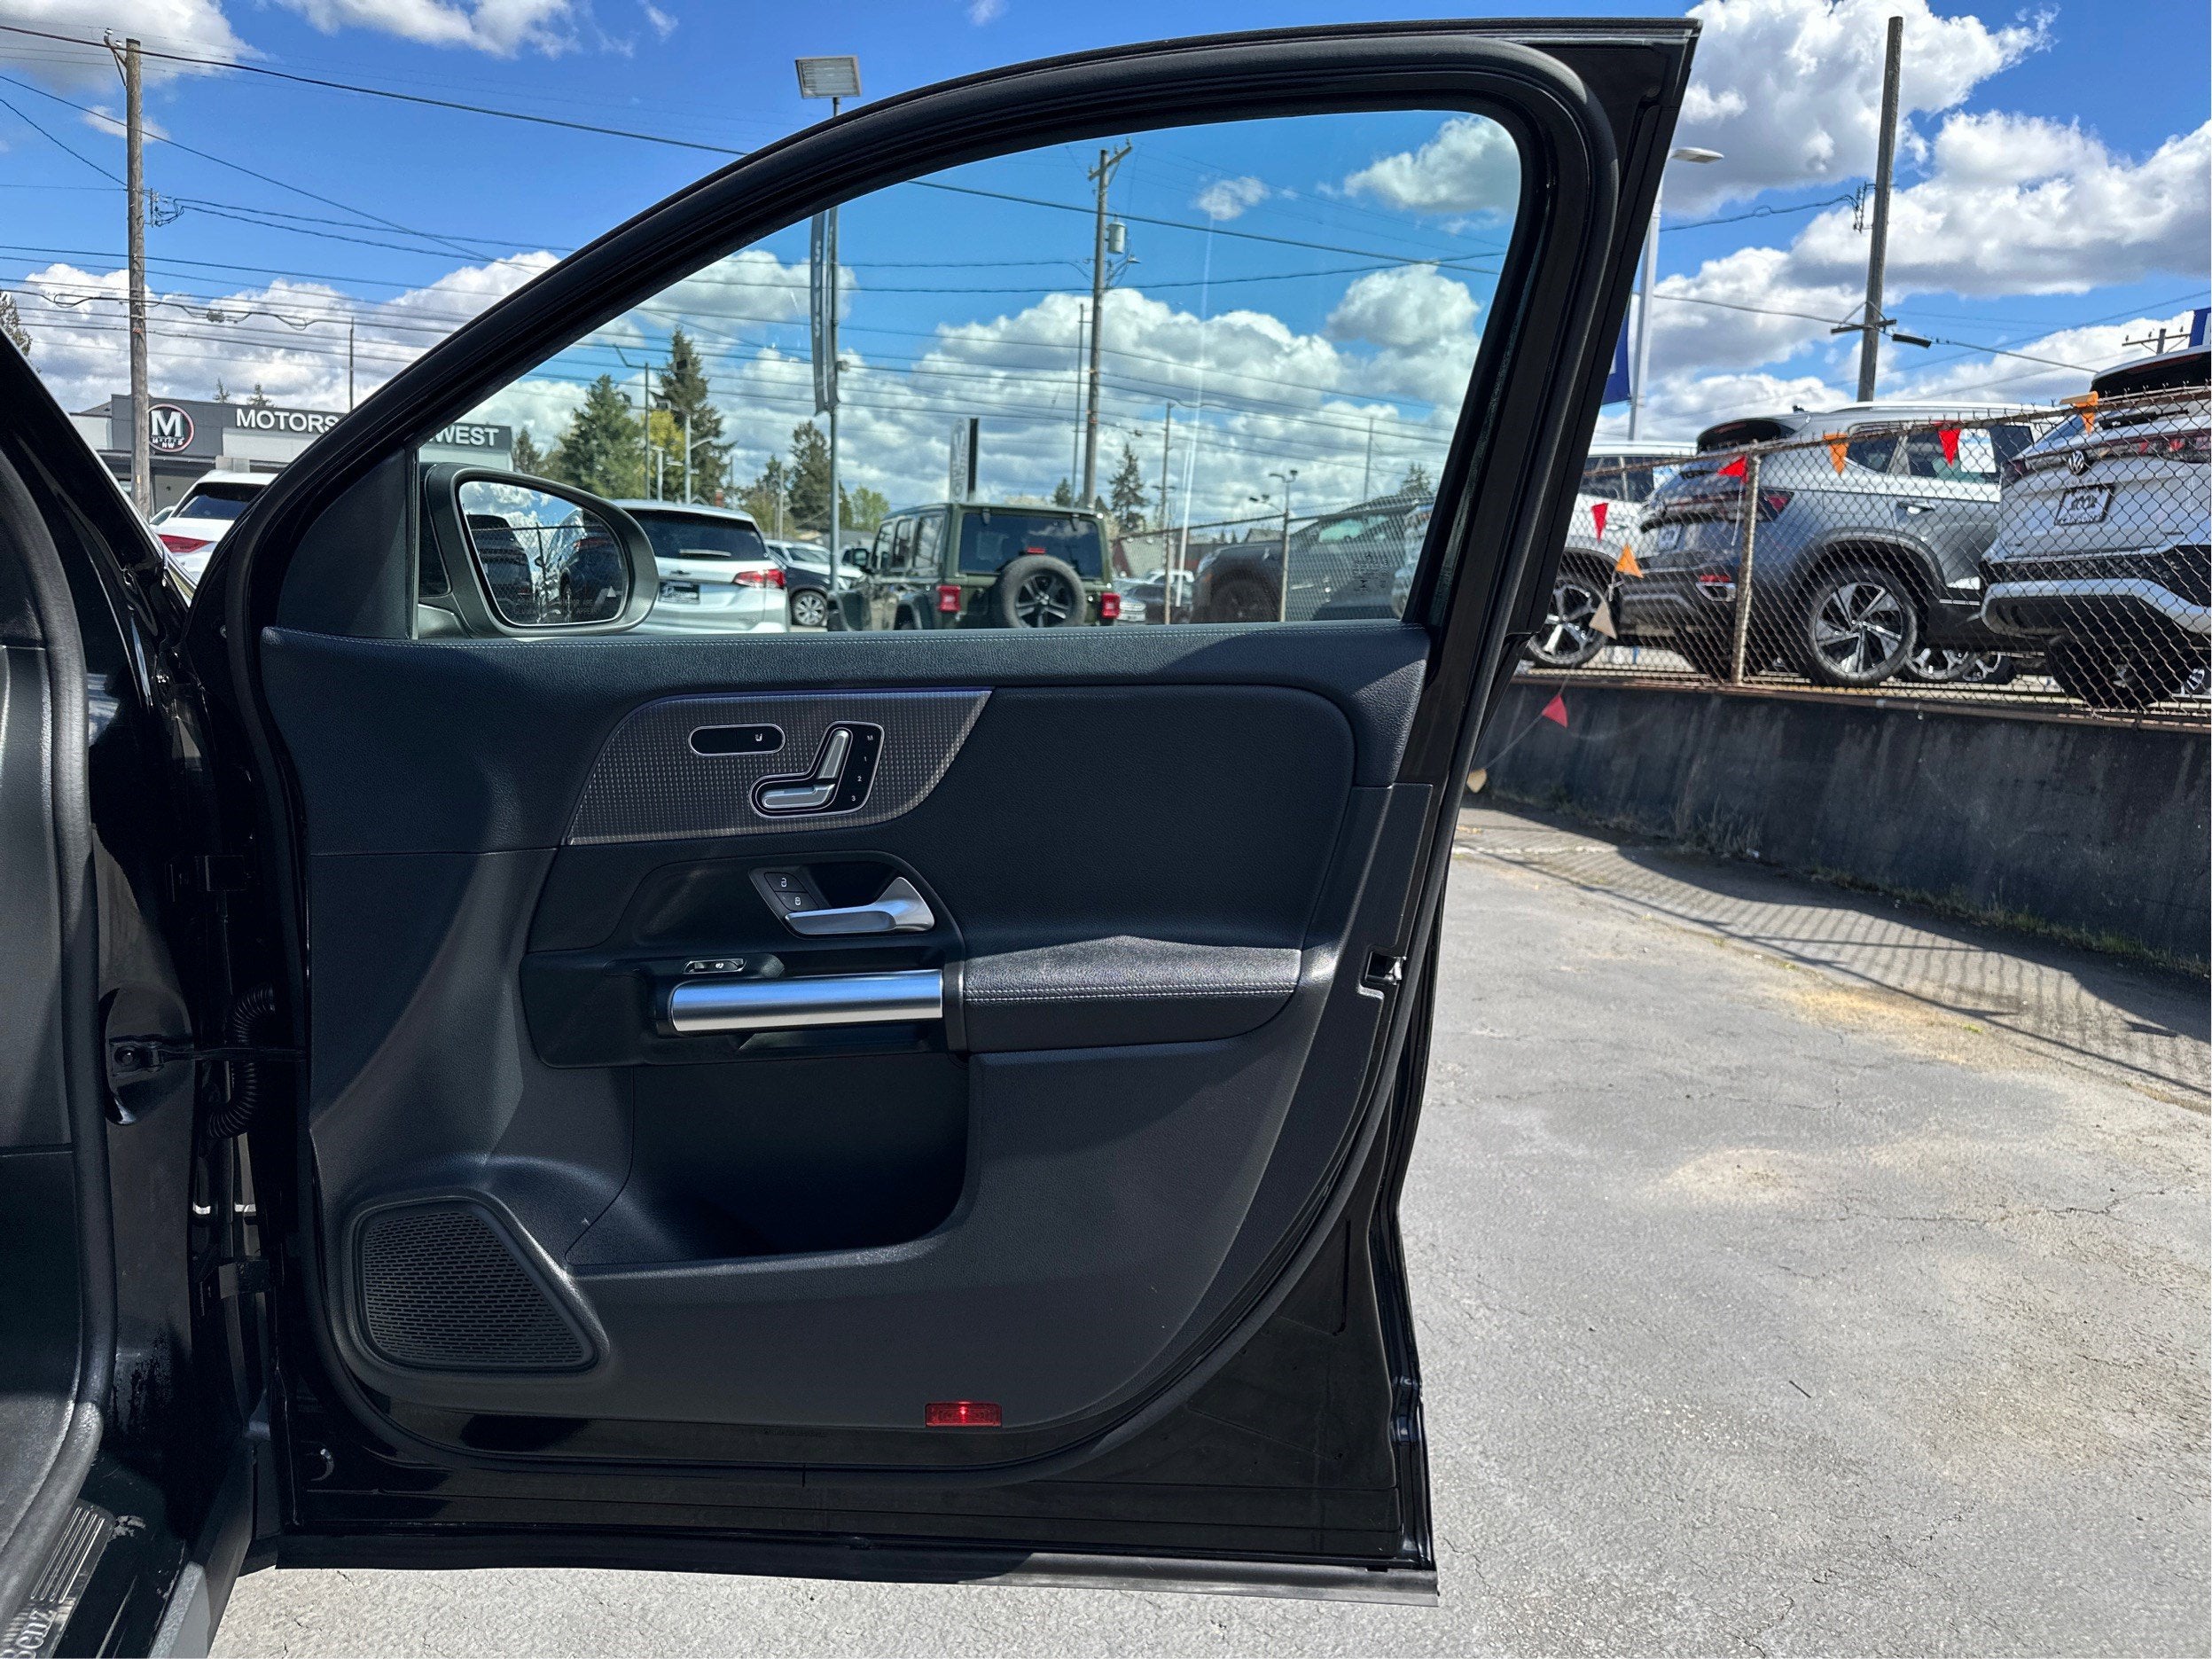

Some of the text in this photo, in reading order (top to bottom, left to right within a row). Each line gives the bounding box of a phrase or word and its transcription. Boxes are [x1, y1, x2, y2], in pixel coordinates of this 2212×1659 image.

[151, 410, 182, 436] M
[236, 408, 500, 446] MOTORS WEST
